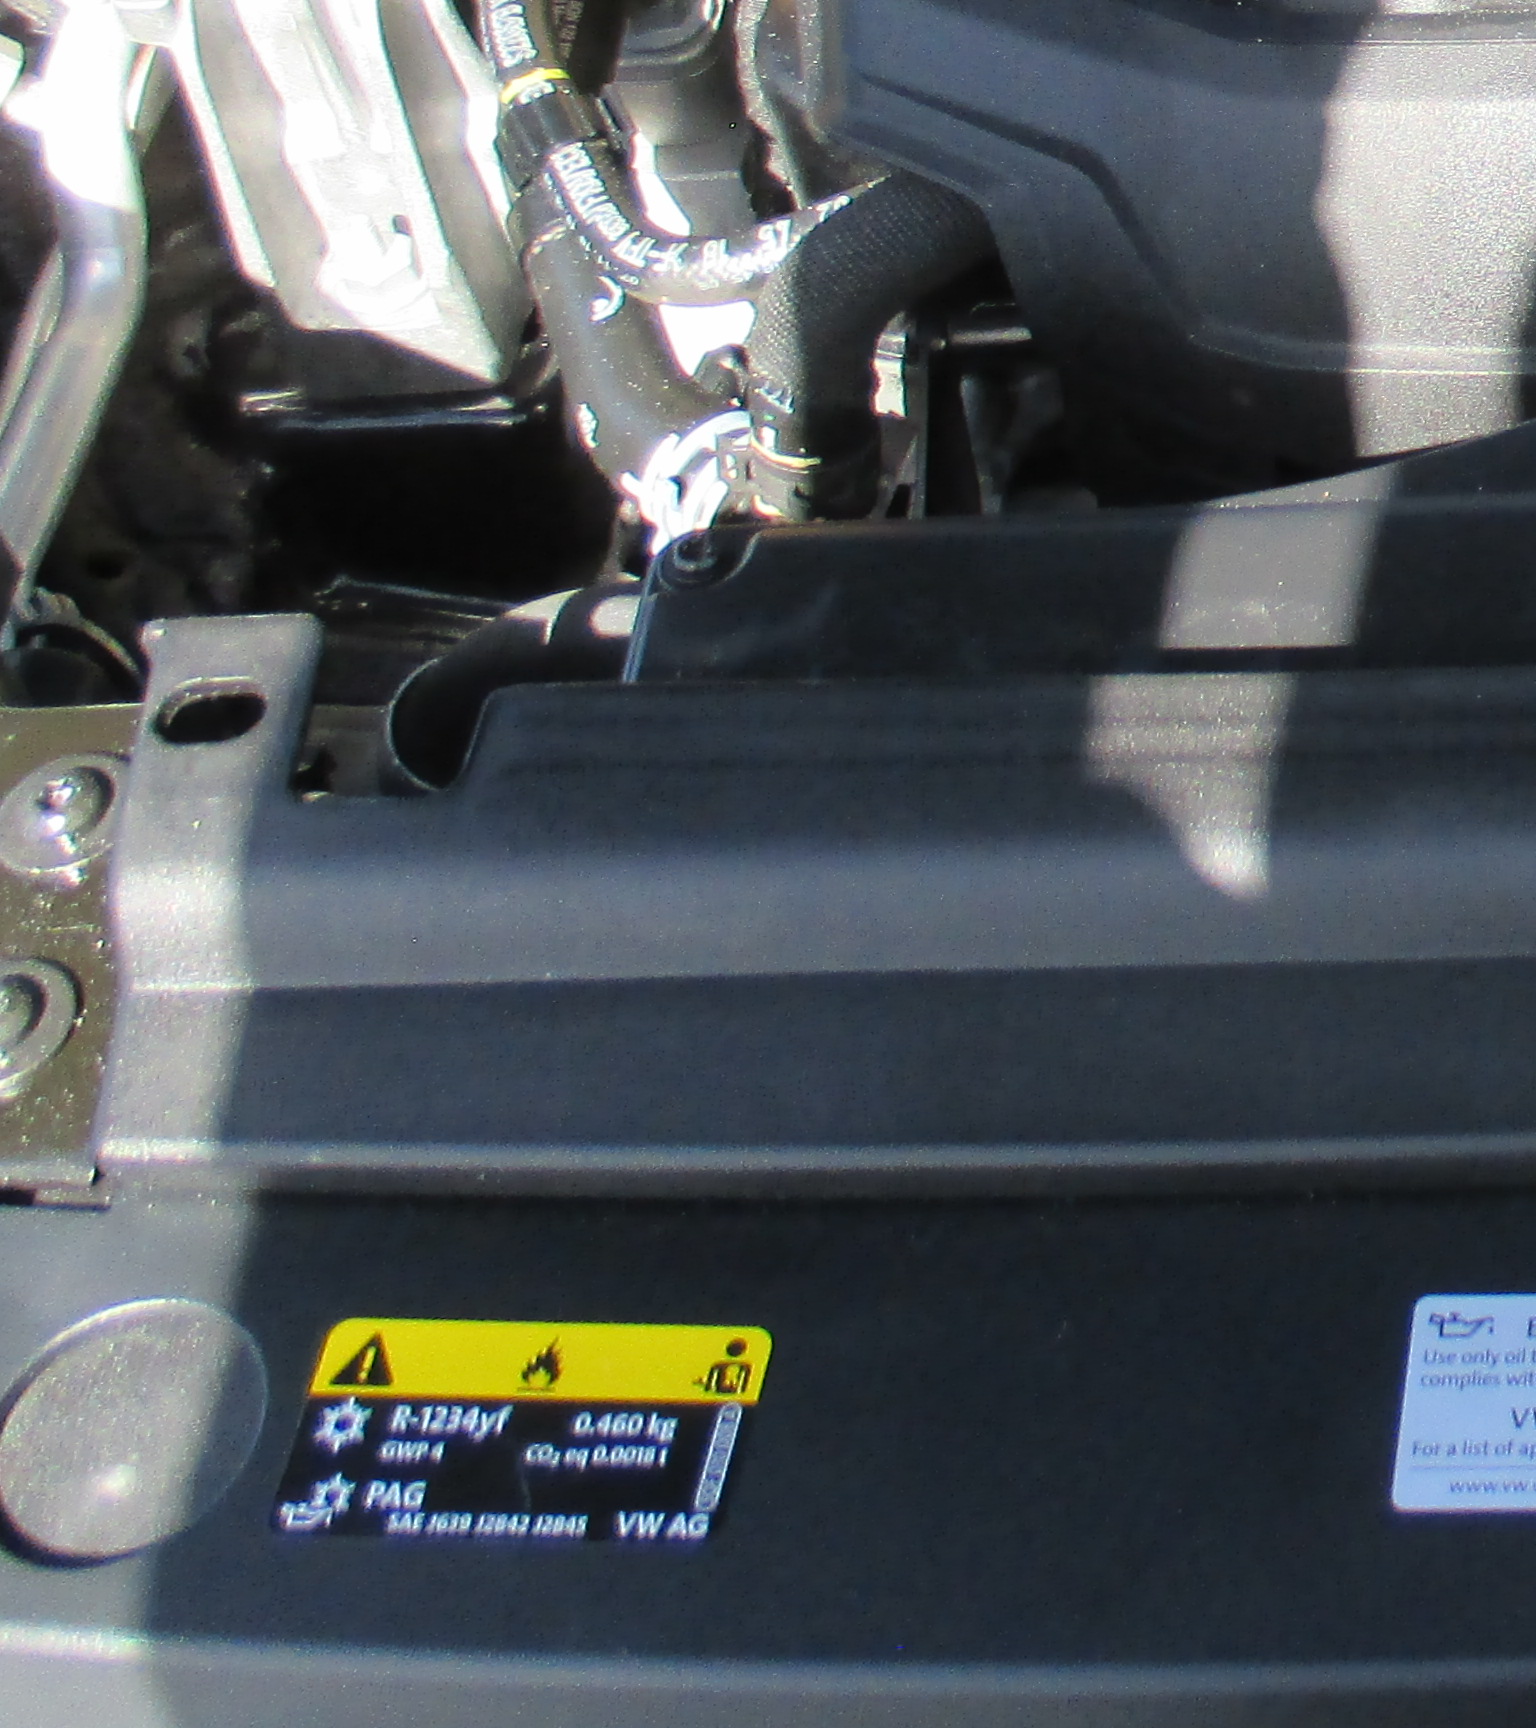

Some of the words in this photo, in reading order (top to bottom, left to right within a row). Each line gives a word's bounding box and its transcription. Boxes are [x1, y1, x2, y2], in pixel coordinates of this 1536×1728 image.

[1423, 1349, 1457, 1365] Use
[1460, 1349, 1500, 1367] only
[1504, 1348, 1527, 1364] oil
[1420, 1372, 1500, 1390] complies
[390, 1404, 514, 1443] R-1234yf
[572, 1410, 645, 1438] 0.460
[646, 1411, 679, 1444] kg
[378, 1440, 429, 1463] GWP
[430, 1440, 447, 1464] 4
[563, 1446, 590, 1472] eq
[1412, 1440, 1442, 1456] For
[1446, 1443, 1458, 1456] a
[1463, 1439, 1489, 1455] list
[1494, 1439, 1514, 1455] of
[364, 1479, 427, 1512] PAG
[387, 1511, 426, 1536] SAE
[616, 1510, 666, 1539] VW
[665, 1511, 710, 1540] AG
